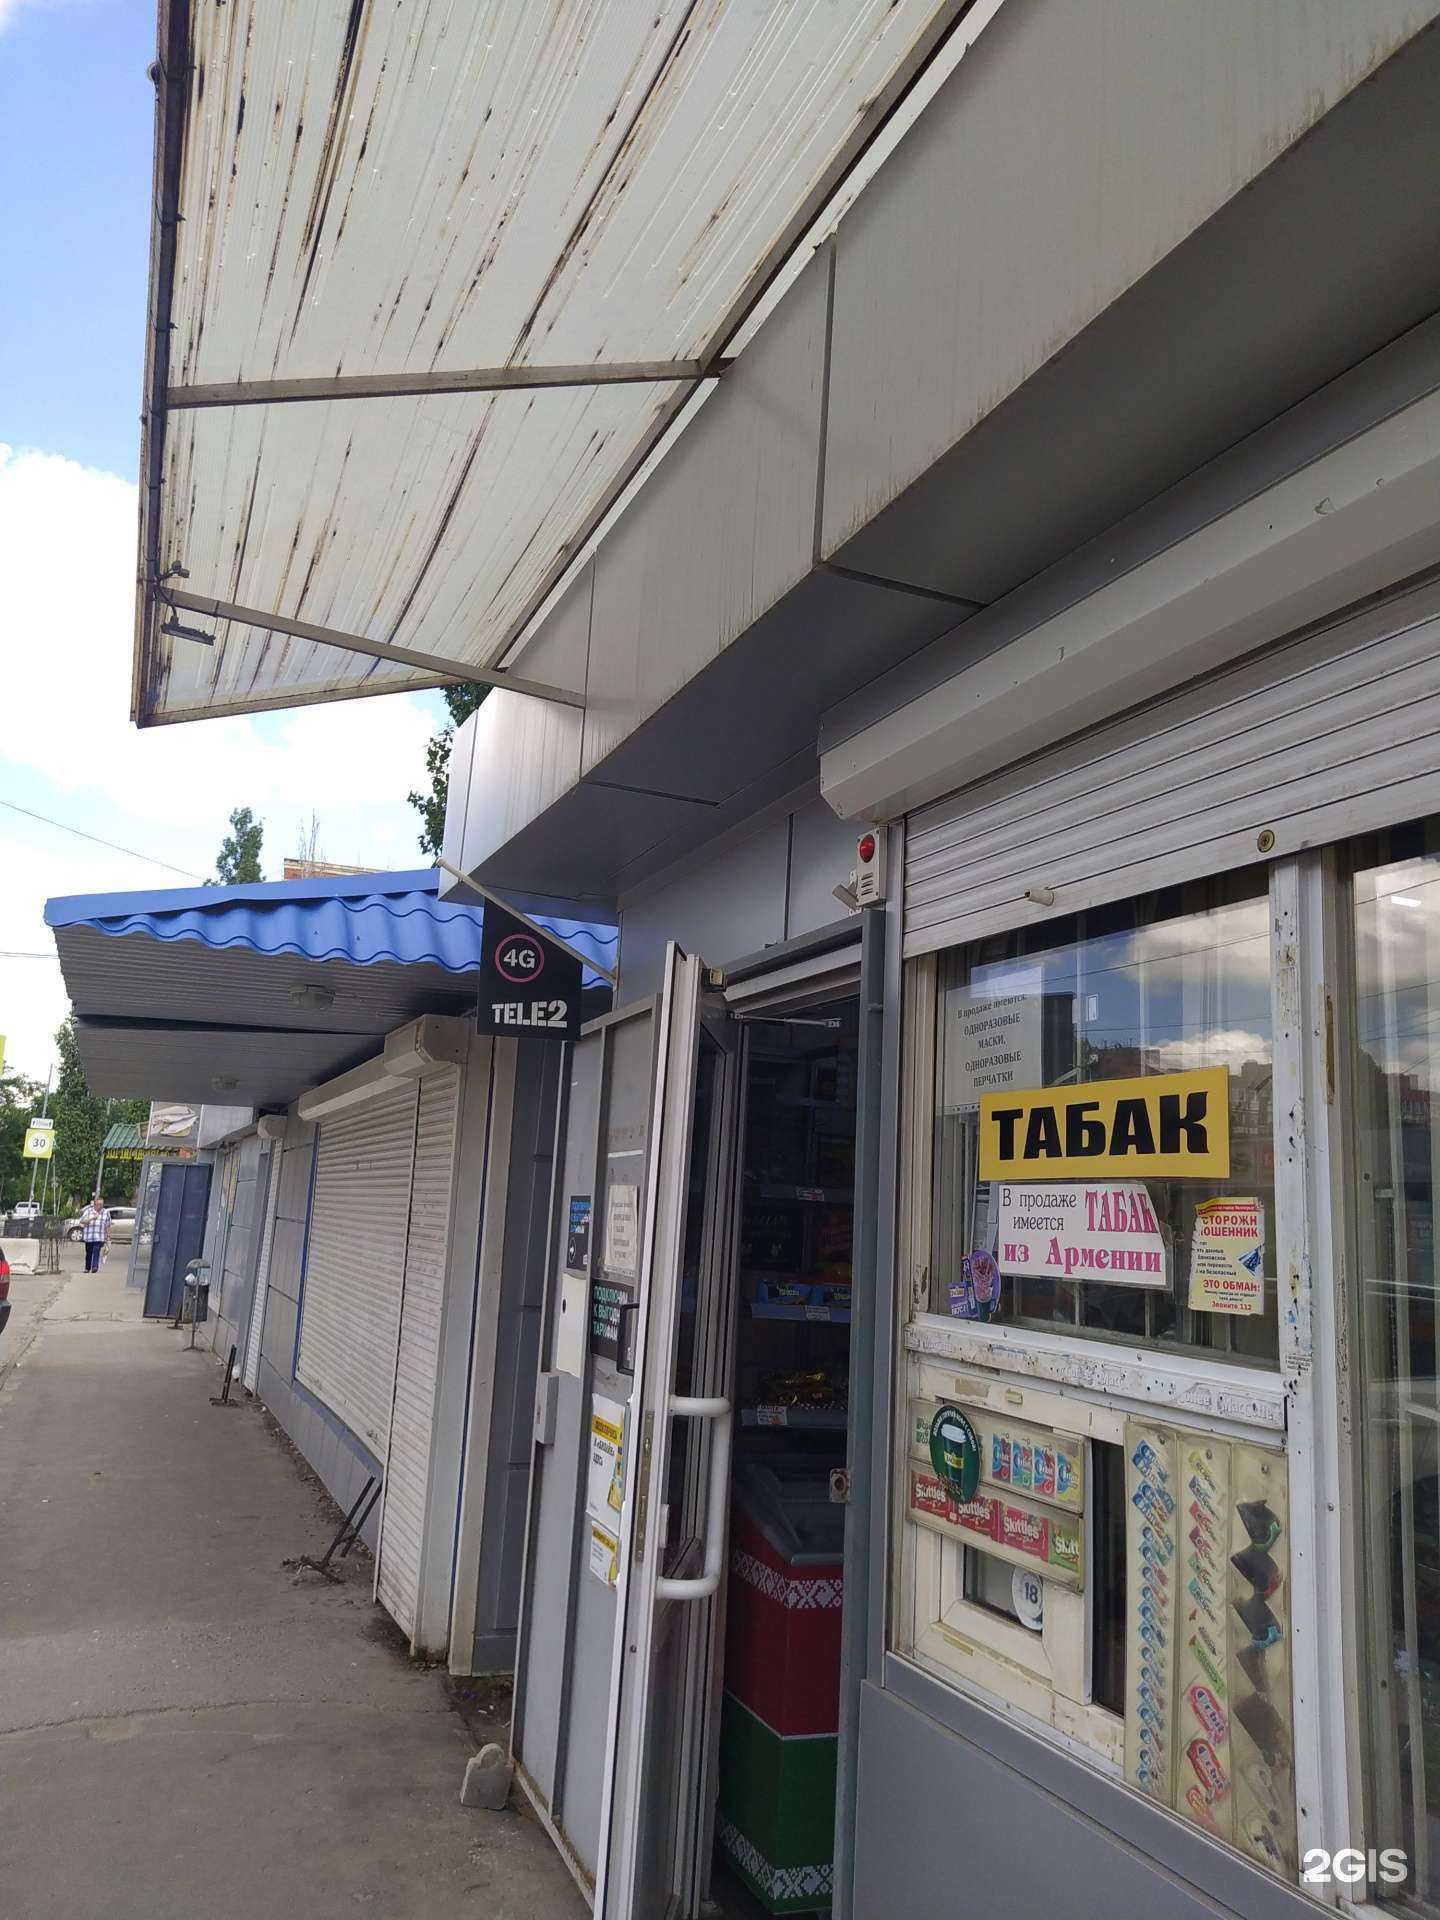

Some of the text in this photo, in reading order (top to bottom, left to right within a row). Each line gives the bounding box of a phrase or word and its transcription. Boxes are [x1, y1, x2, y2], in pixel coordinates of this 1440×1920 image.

[503, 948, 536, 969] 4G
[491, 1000, 568, 1028] TELE2
[963, 1003, 992, 1018] продаже
[963, 1013, 1021, 1036] ОДНОРАЗОВЫЕ
[964, 1051, 1022, 1073] ОДНОРАЗОВЫЕ
[973, 1070, 1014, 1088] ПЕРЧАТКИ
[991, 1091, 1209, 1161] ТАБАК
[33, 1138, 46, 1148] 30
[1002, 1187, 1077, 1212] В продаже
[1013, 1215, 1064, 1231] имеется
[1003, 1236, 1162, 1275] из Армении
[1203, 1279, 1220, 1289] ЭТО
[915, 1483, 946, 1503] Skittles
[1003, 1516, 1040, 1539] Skittles
